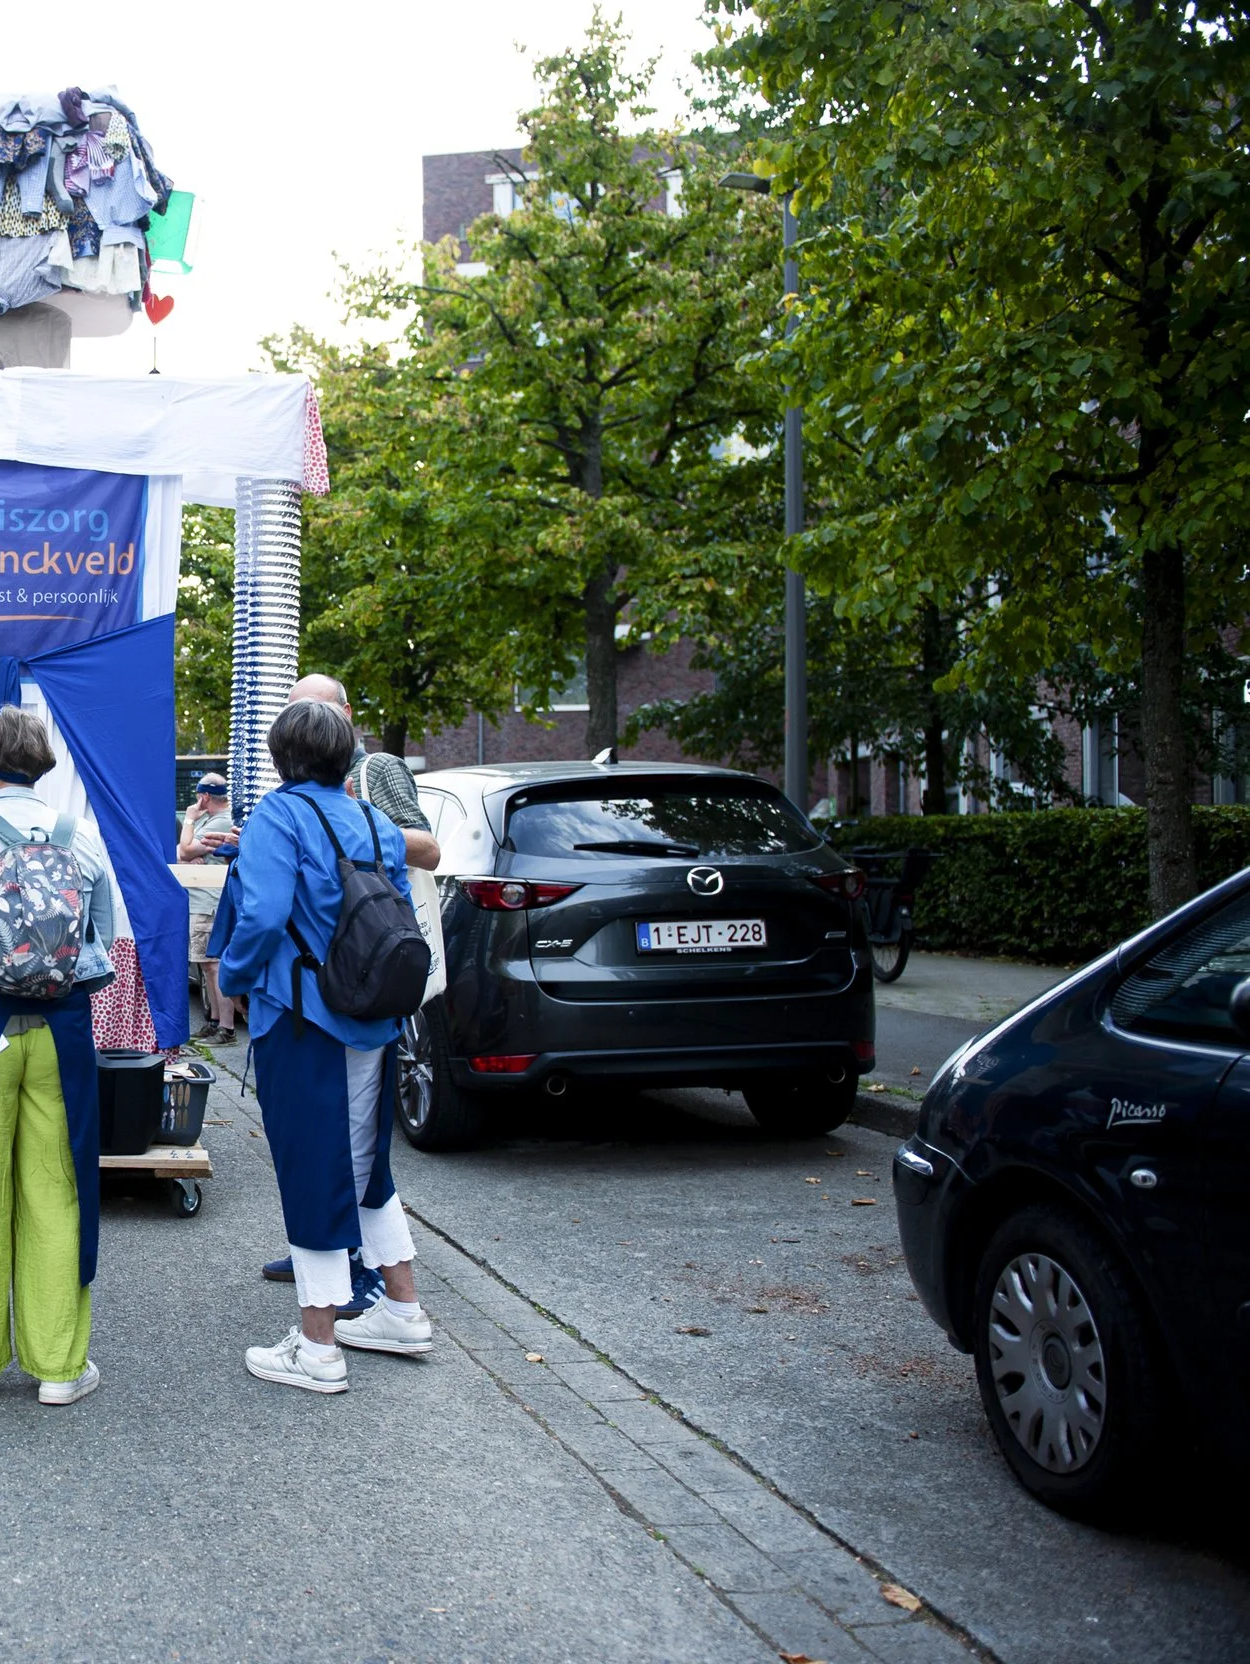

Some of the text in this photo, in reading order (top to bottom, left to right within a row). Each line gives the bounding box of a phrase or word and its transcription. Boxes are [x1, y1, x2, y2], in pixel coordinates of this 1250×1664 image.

[16, 588, 28, 603] &
[32, 588, 118, 607] persoonlijk
[535, 939, 573, 948] CX-5
[641, 938, 649, 947] B
[1106, 1097, 1167, 1130] Picasso
